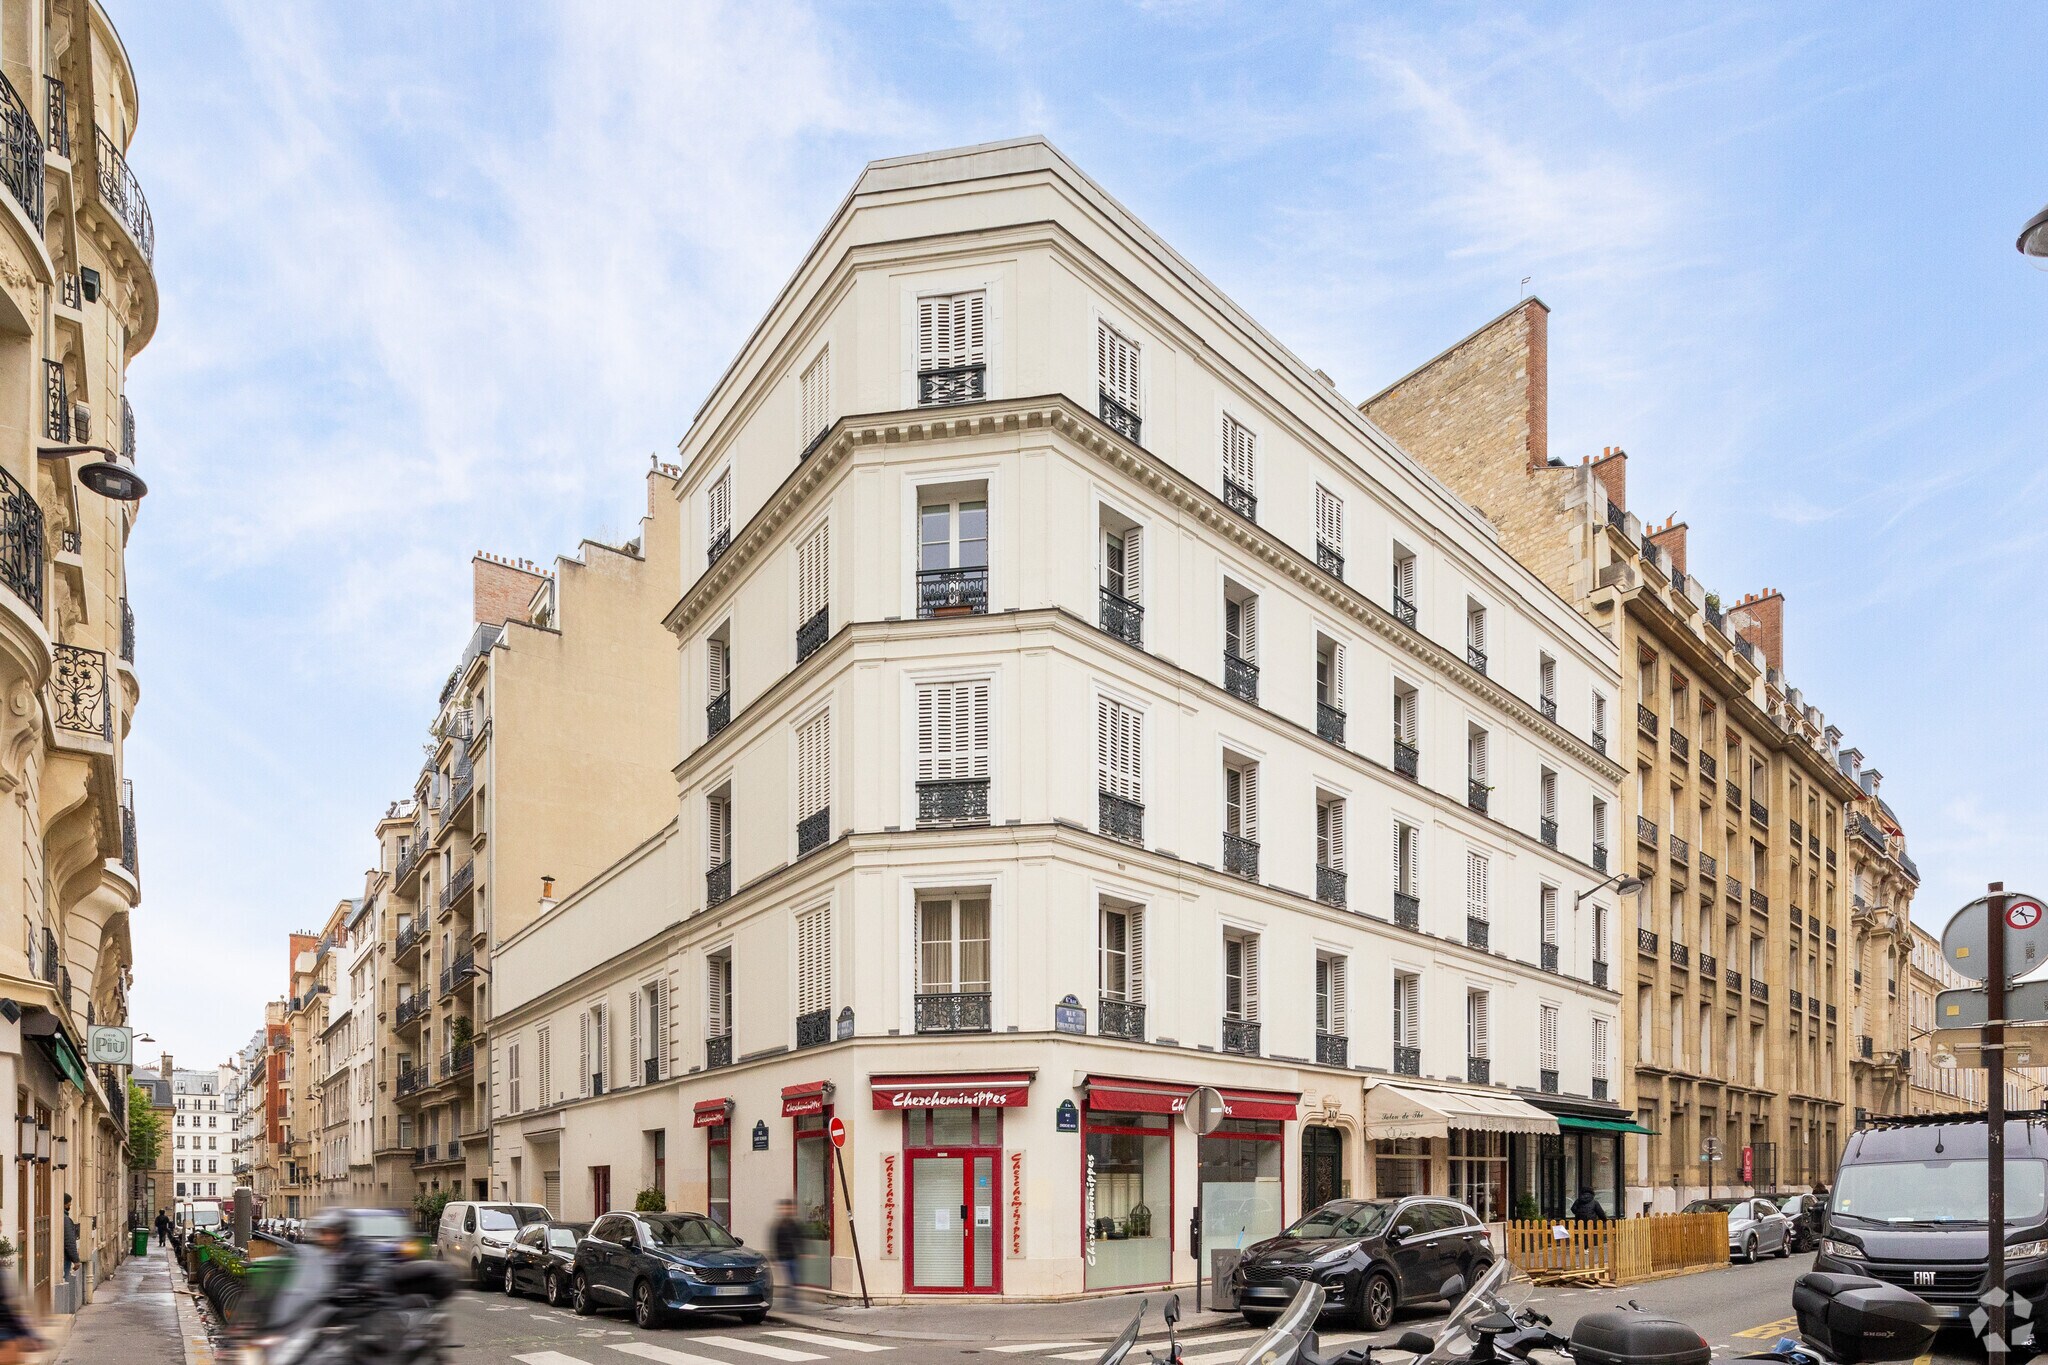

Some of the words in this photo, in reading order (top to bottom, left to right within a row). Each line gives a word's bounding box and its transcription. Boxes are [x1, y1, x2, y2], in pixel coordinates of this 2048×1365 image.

[95, 1037, 125, 1053] Più
[892, 1091, 1007, 1107] Chercheminippes
[1402, 1112, 1410, 1120] de
[884, 1155, 895, 1256] Chercheminippes
[1011, 1153, 1022, 1255] Chercheminippes
[1086, 1154, 1098, 1267] Chercheminippes
[1914, 1271, 1936, 1285] FIAT
